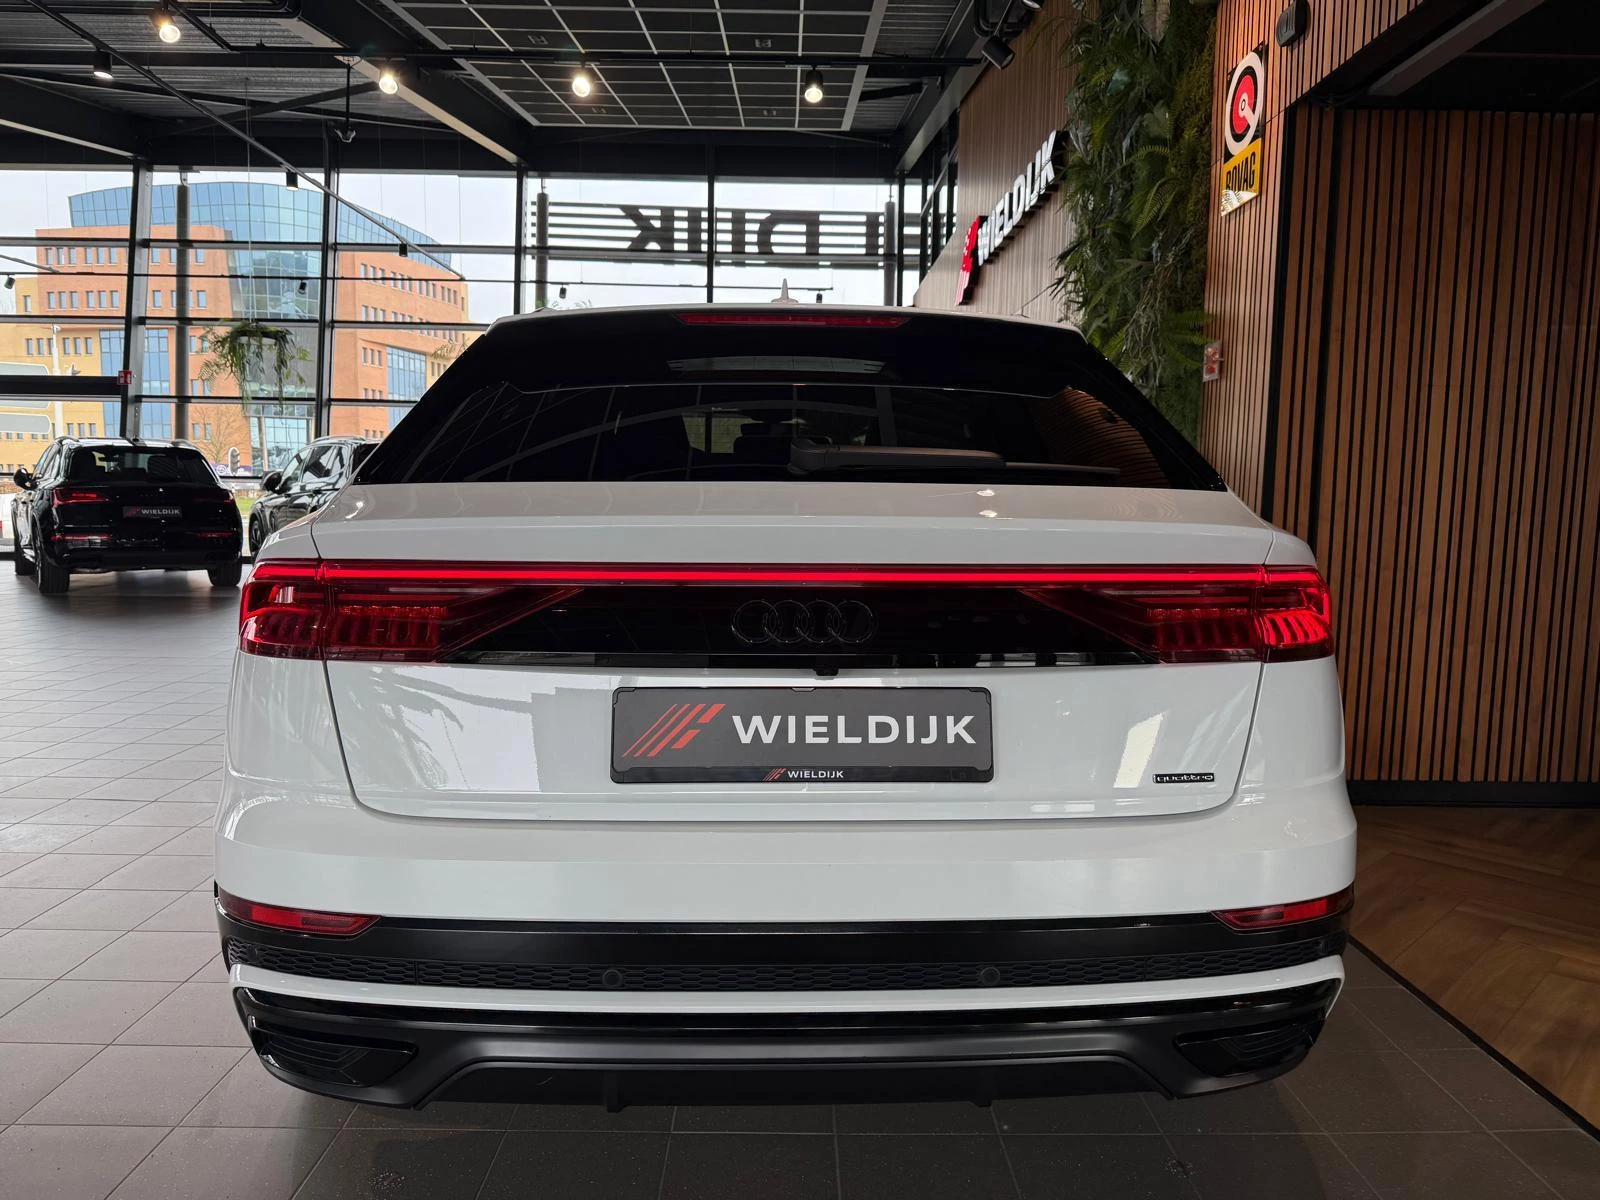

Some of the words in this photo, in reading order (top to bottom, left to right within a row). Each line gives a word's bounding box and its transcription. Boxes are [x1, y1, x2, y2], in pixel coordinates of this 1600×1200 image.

[977, 130, 1058, 267] WIELDIJK
[731, 715, 977, 745] WIELDIJK
[787, 770, 845, 779] WIELDIJK
[1156, 774, 1214, 783] quattro
